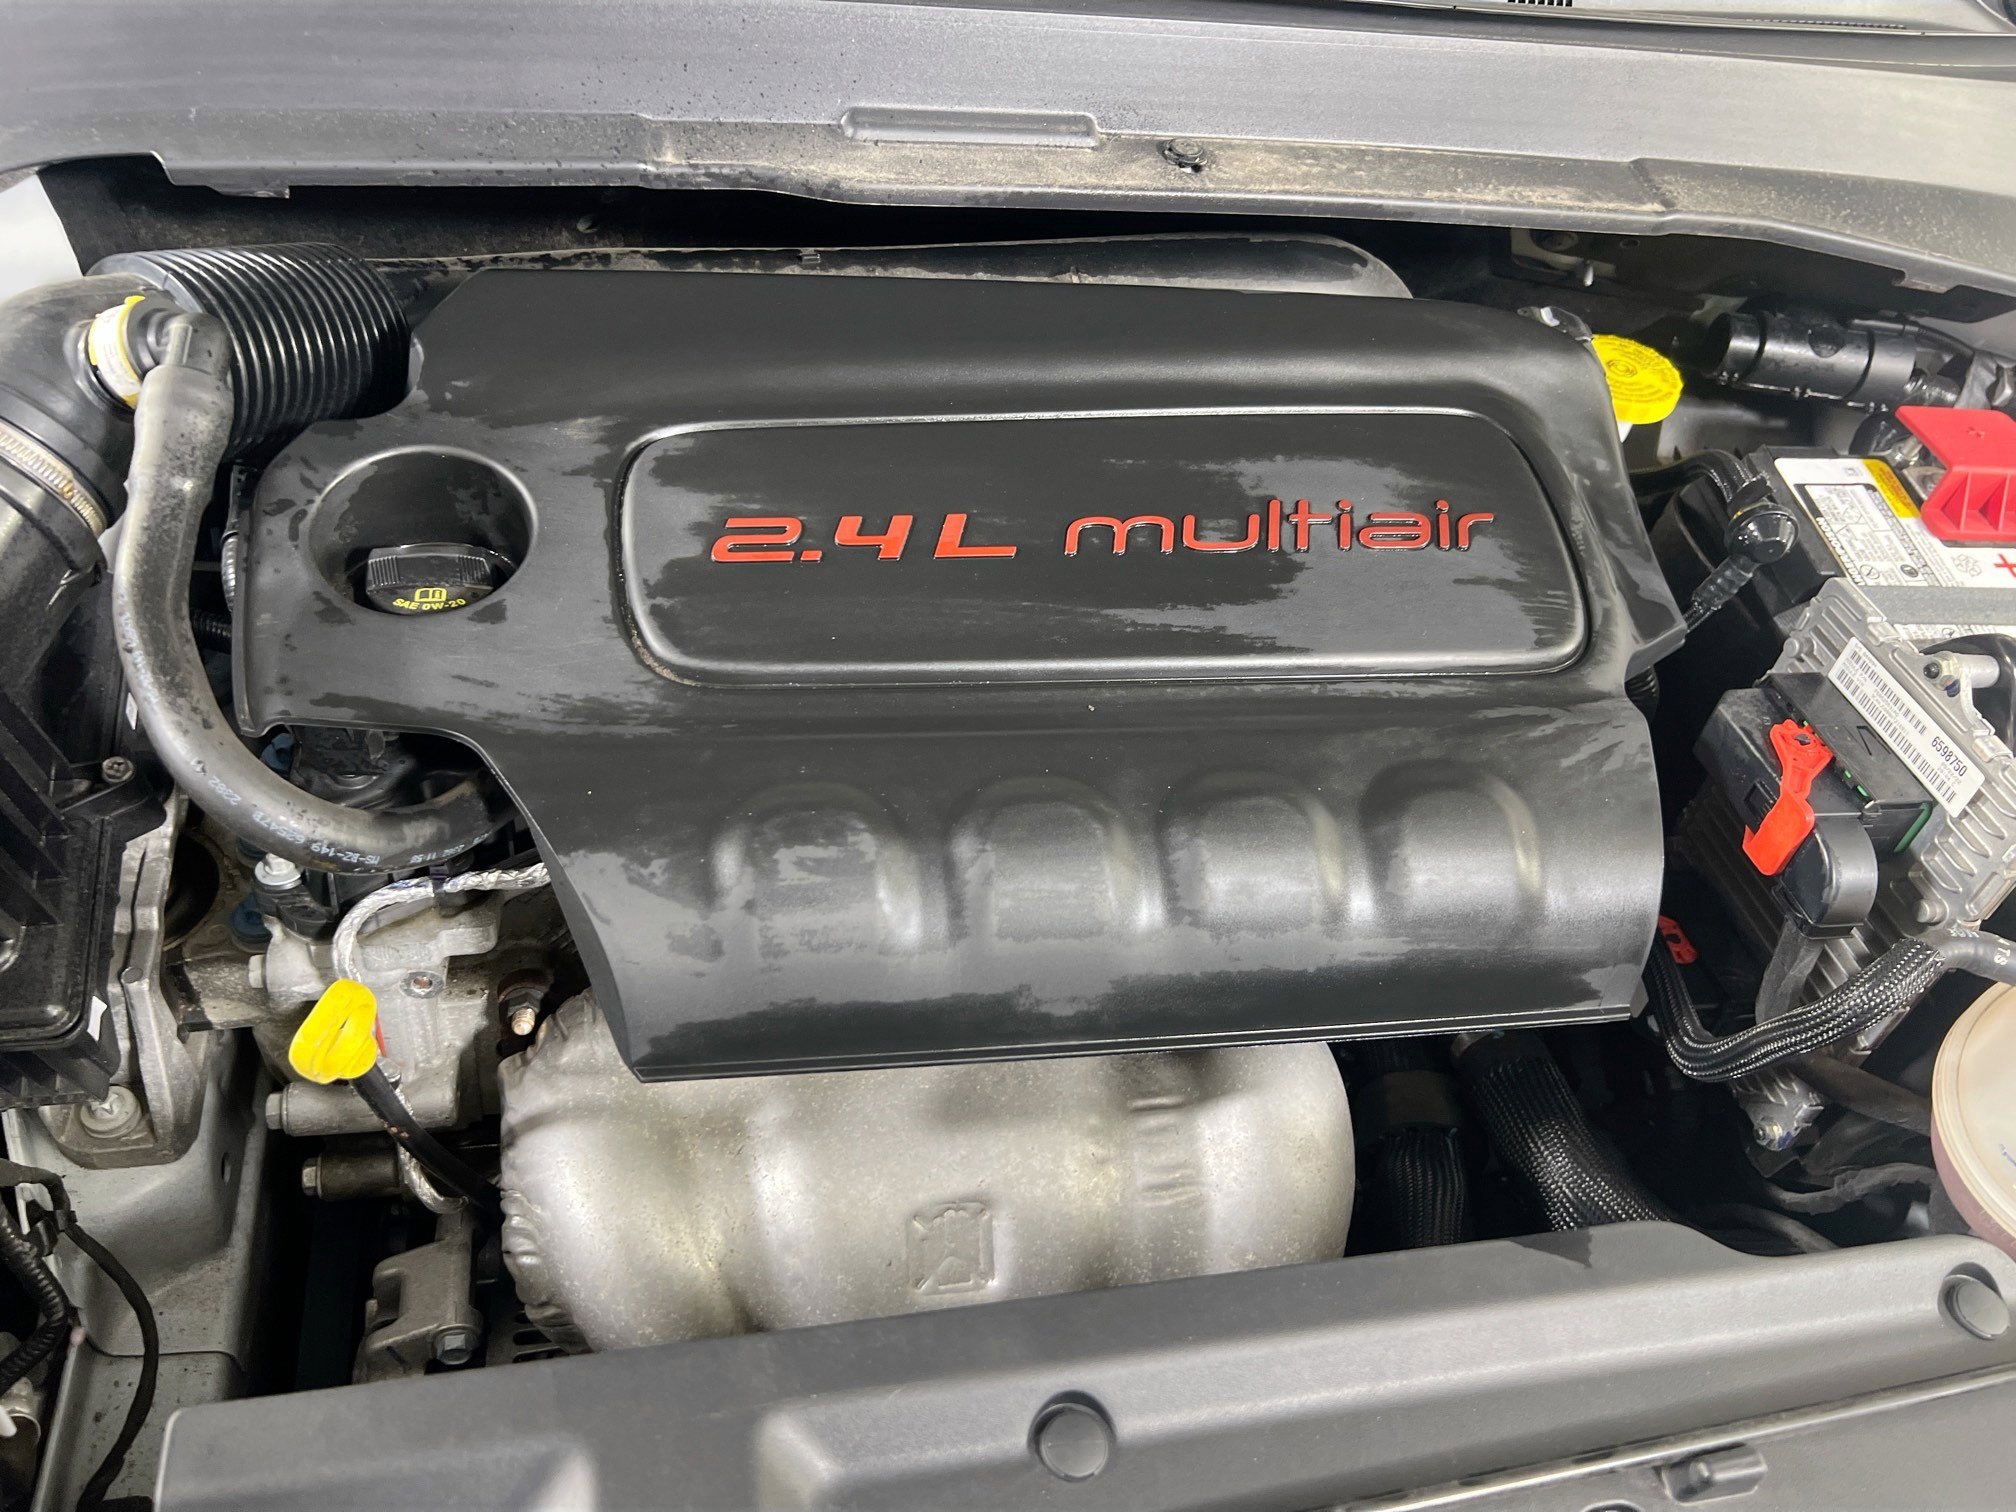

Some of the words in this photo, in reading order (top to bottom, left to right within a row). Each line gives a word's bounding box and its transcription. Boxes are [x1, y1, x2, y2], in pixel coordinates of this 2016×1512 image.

[1065, 499, 1495, 553] multiair
[393, 599, 419, 610] SAE
[422, 598, 465, 611] 0W-20
[1930, 736, 1967, 777] 6598750
